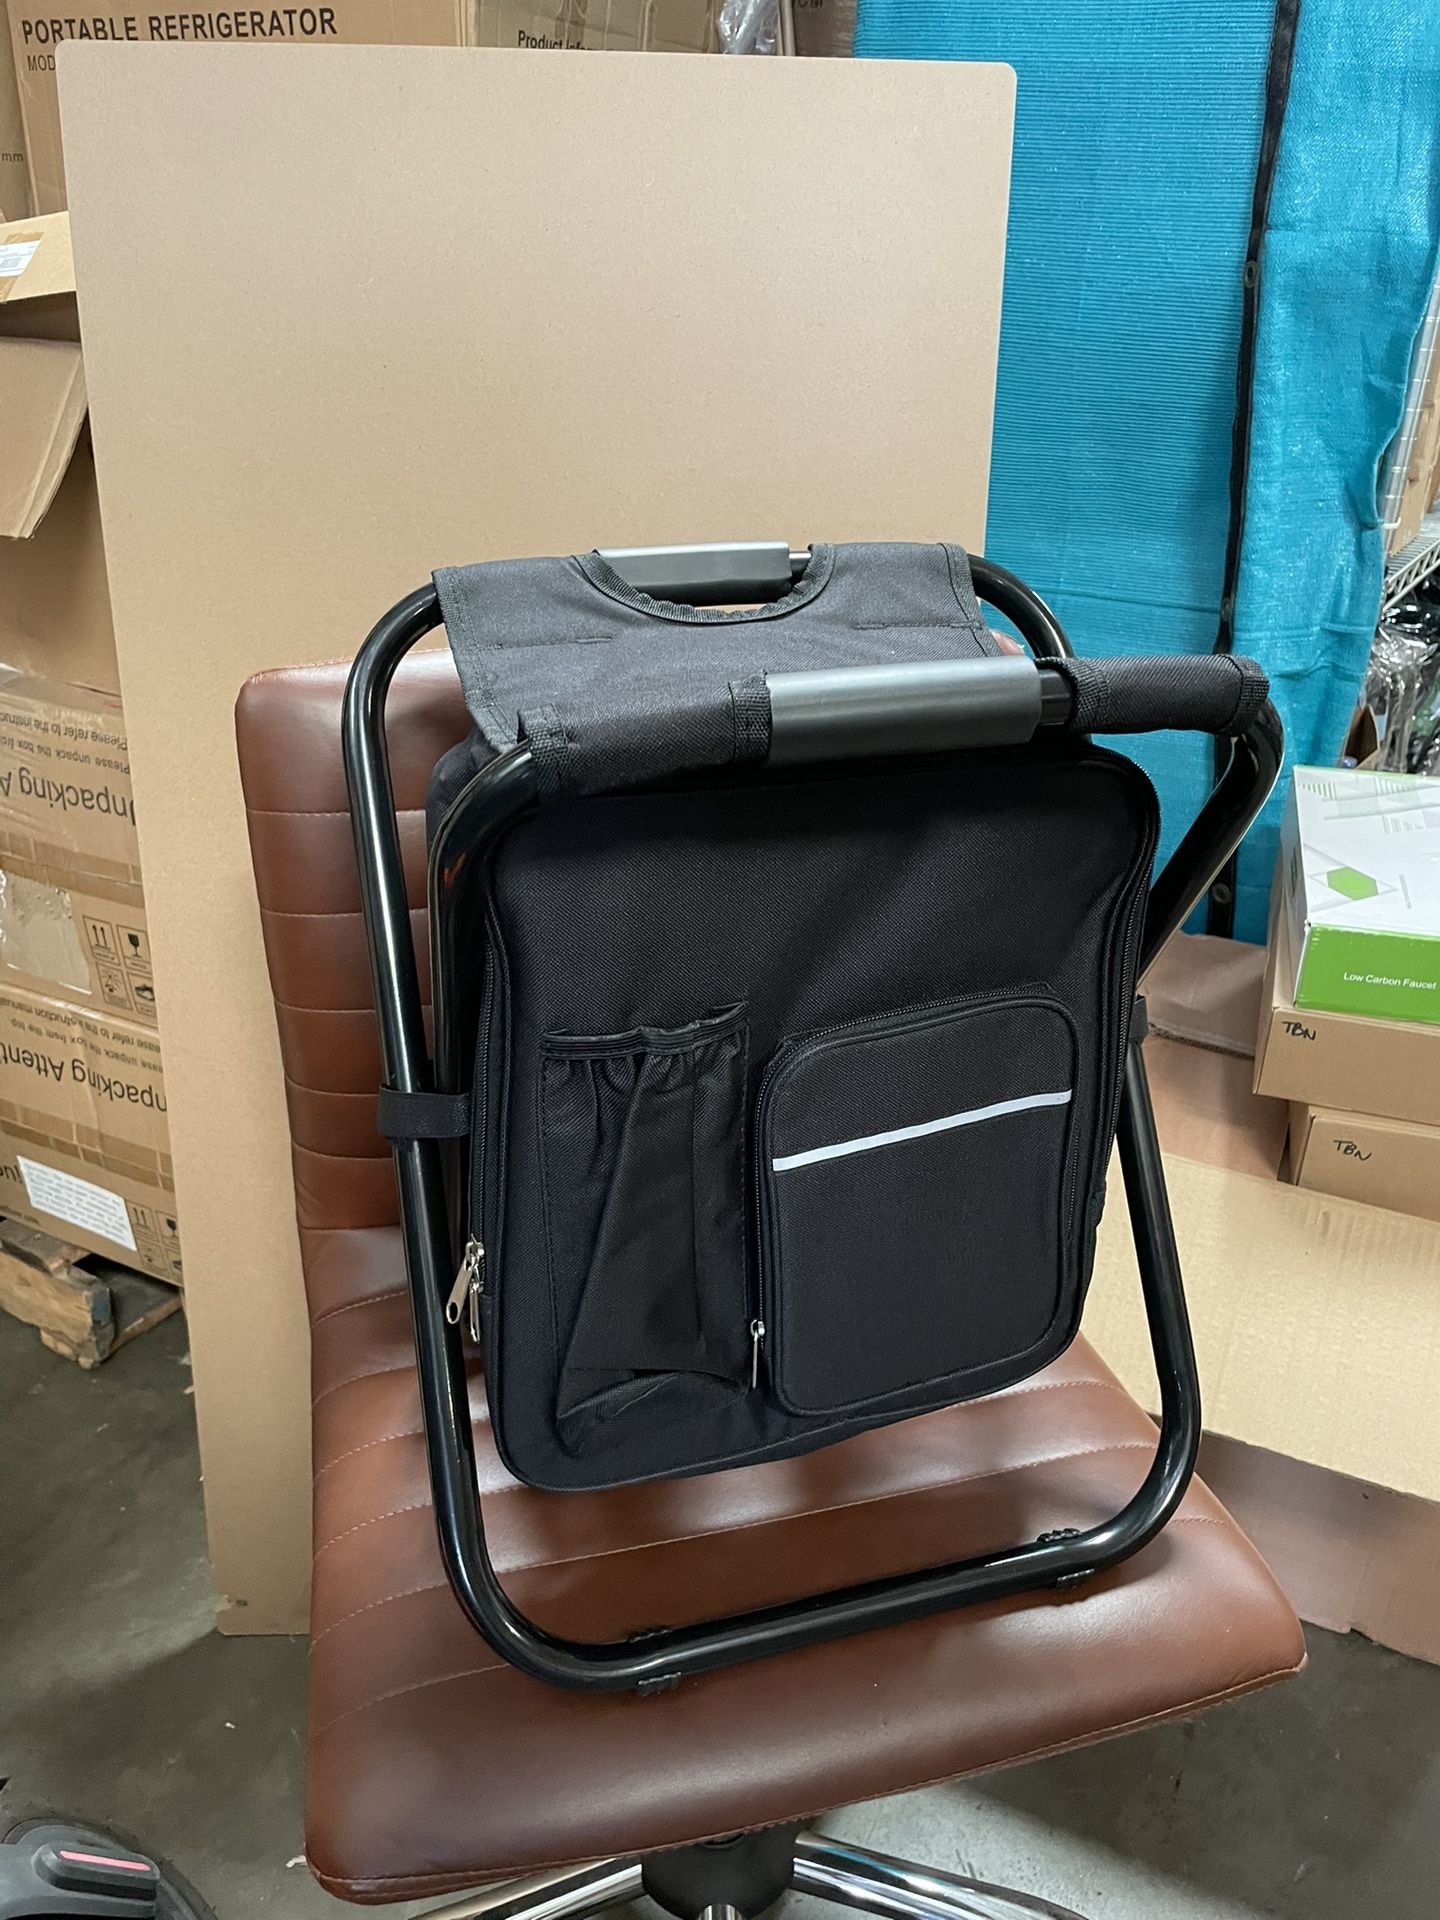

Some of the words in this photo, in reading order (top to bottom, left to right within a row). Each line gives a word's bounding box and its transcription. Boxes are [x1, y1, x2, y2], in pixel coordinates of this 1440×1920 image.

[22, 17, 138, 44] PORTABLE
[148, 8, 338, 40] REFRIGERATOR
[51, 723, 61, 736] to
[64, 726, 88, 741] refer
[1343, 971, 1364, 981] Low
[1365, 974, 1401, 986] Carbon
[1402, 978, 1437, 990] Faucet
[1282, 1021, 1316, 1040] TBN
[1333, 1140, 1372, 1161] TBN
